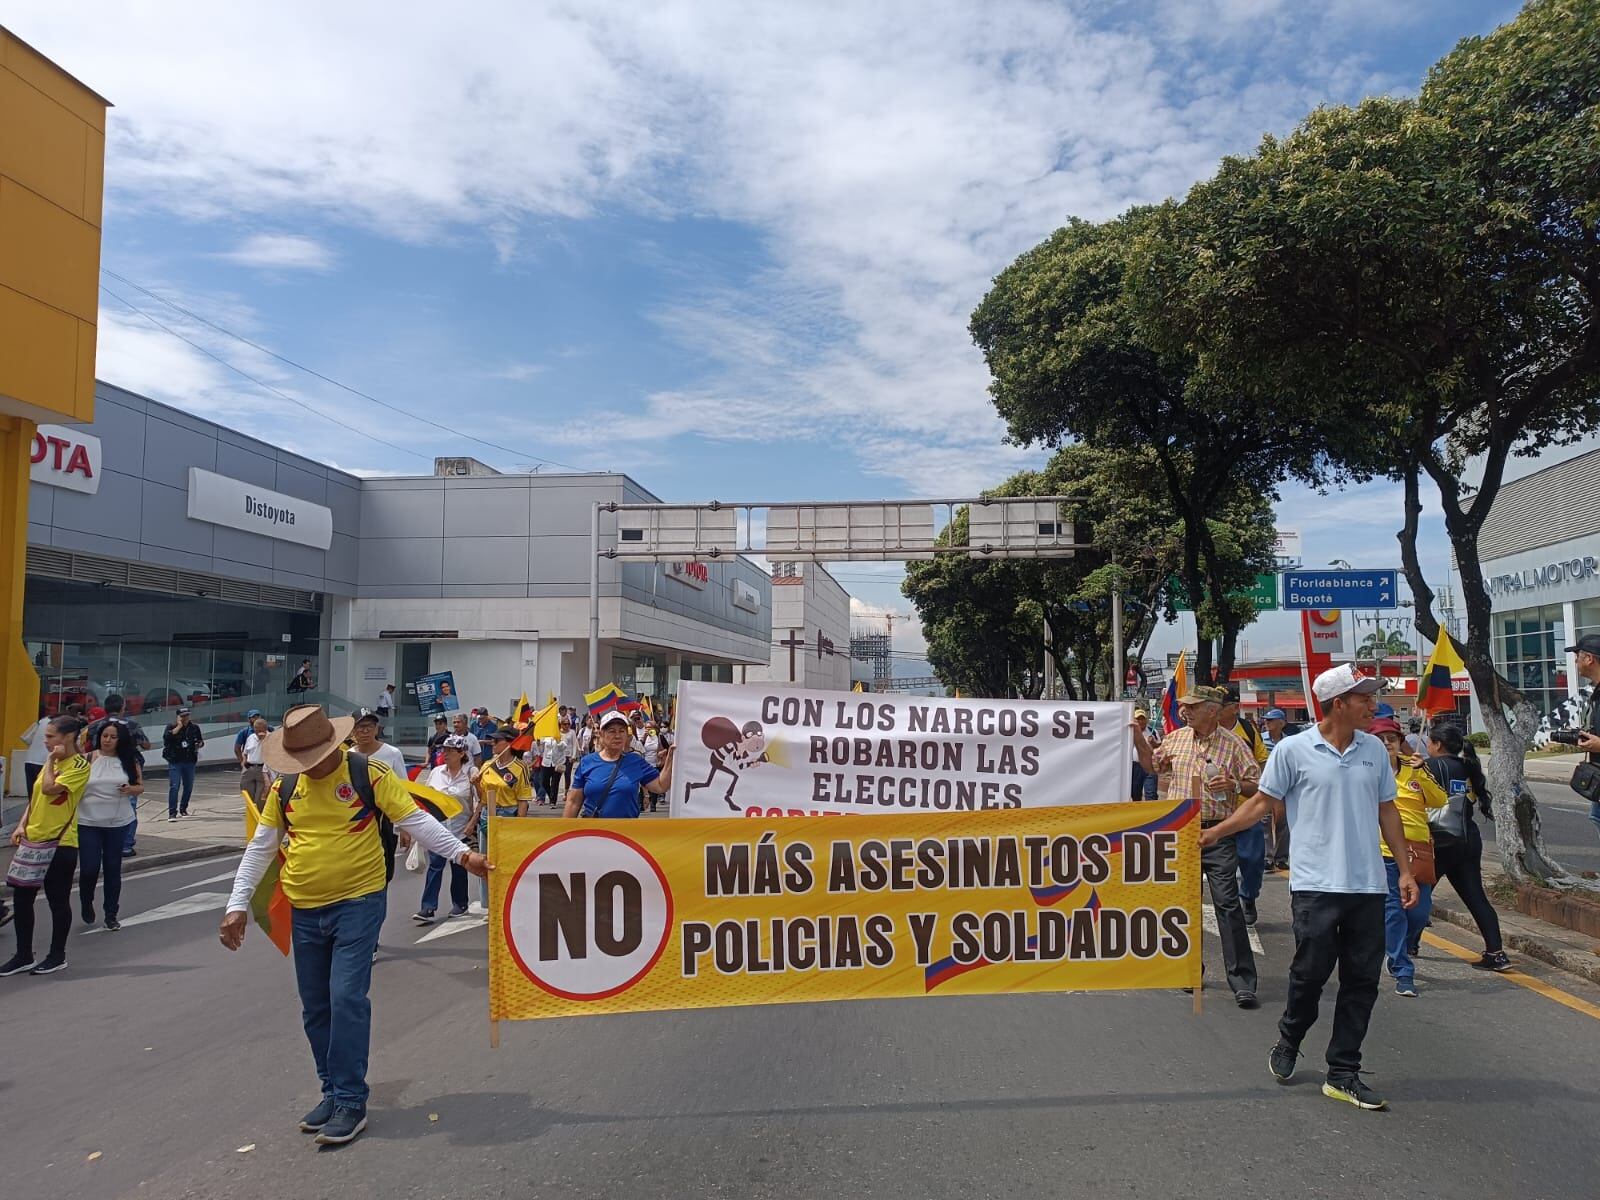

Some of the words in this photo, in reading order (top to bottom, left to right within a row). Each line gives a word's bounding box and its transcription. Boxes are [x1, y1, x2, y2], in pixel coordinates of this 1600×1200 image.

[245, 495, 295, 525] Distoyota
[1290, 577, 1373, 588] Floridablanca
[1290, 593, 1333, 604] Bogotá
[1313, 631, 1338, 640] terpel
[761, 696, 823, 727] CON
[835, 701, 895, 731] LOS
[909, 706, 1038, 738] NARCOS
[1052, 710, 1094, 740] SE
[810, 735, 963, 772] ROBARON
[976, 744, 1040, 776] LAS
[812, 772, 1022, 810] ELECCIONES
[706, 832, 813, 896] MÁS
[829, 835, 1110, 892] ASESINATOS
[1123, 832, 1176, 883] DE
[538, 869, 643, 962] NO
[682, 910, 893, 976] POLICIAS
[909, 910, 937, 965] Y
[953, 907, 1188, 963] SOLDADOS
